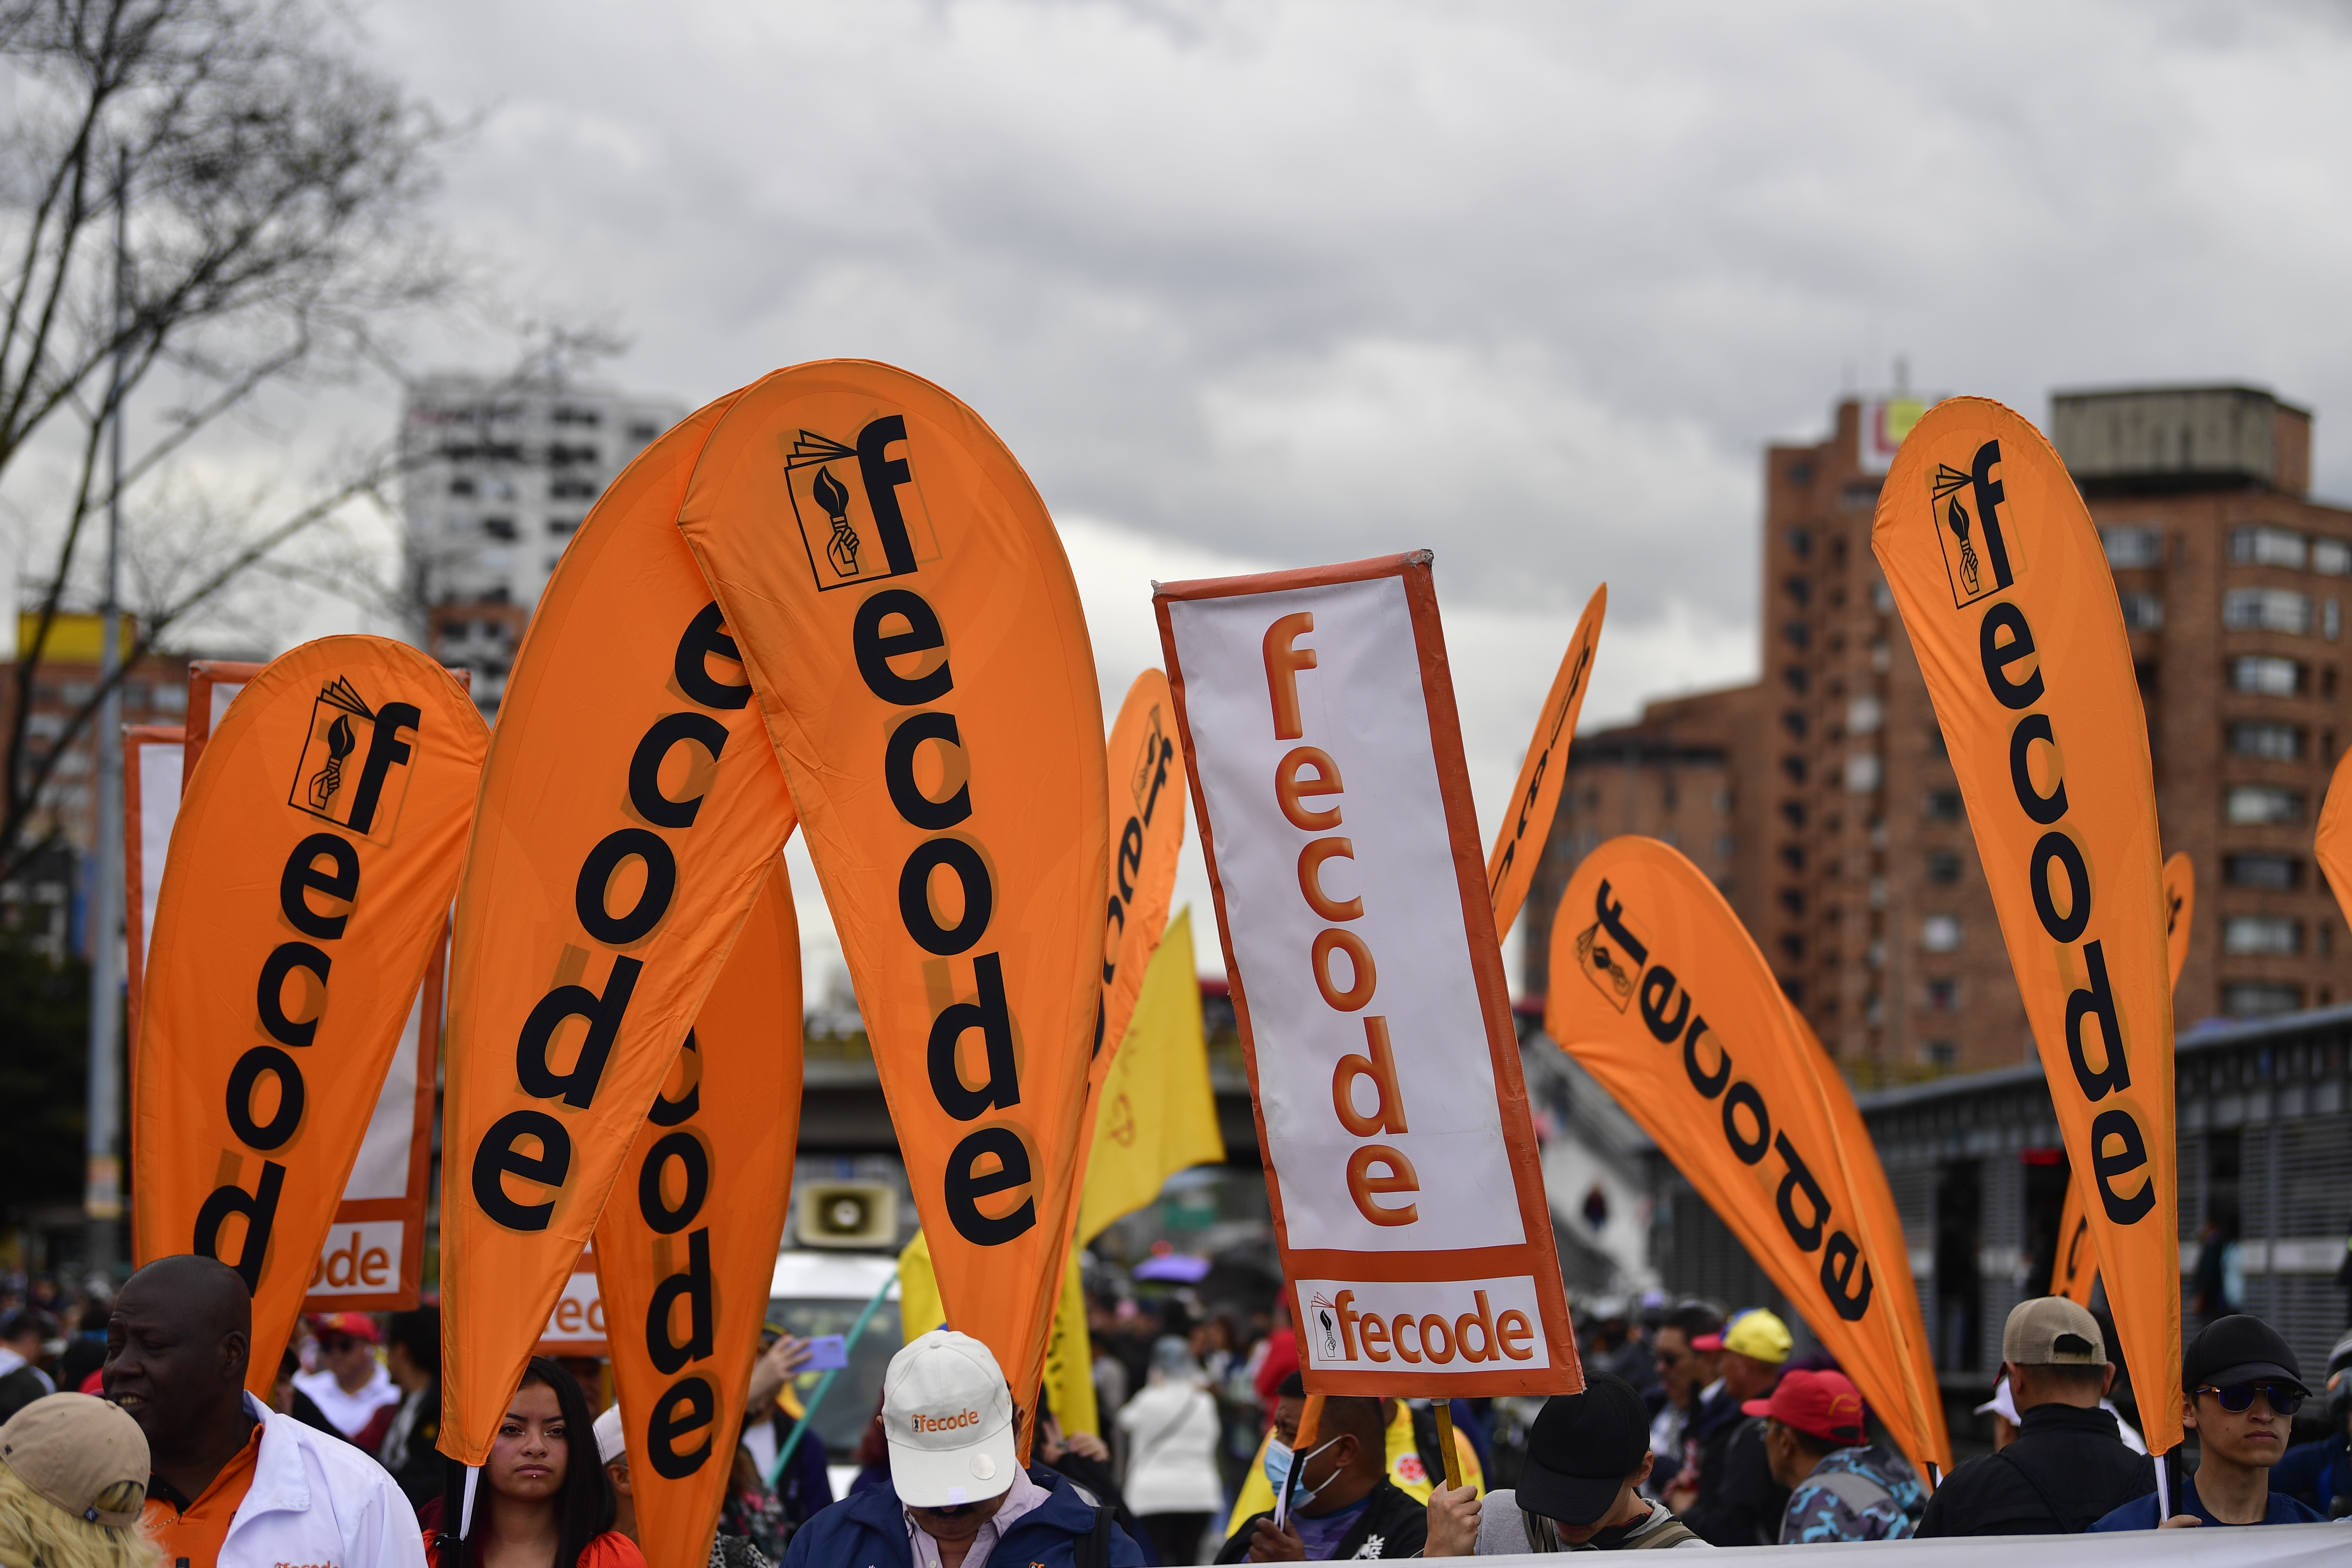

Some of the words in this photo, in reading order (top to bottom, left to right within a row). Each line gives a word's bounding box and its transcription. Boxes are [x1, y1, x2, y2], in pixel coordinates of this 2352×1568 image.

[853, 414, 1036, 1247] fecode
[1262, 611, 1420, 1227] fecode
[1971, 439, 2156, 1225] fecode
[1334, 1289, 1534, 1364] fecode
[1597, 877, 1873, 1322] fecode
[920, 1408, 979, 1432] fecode
